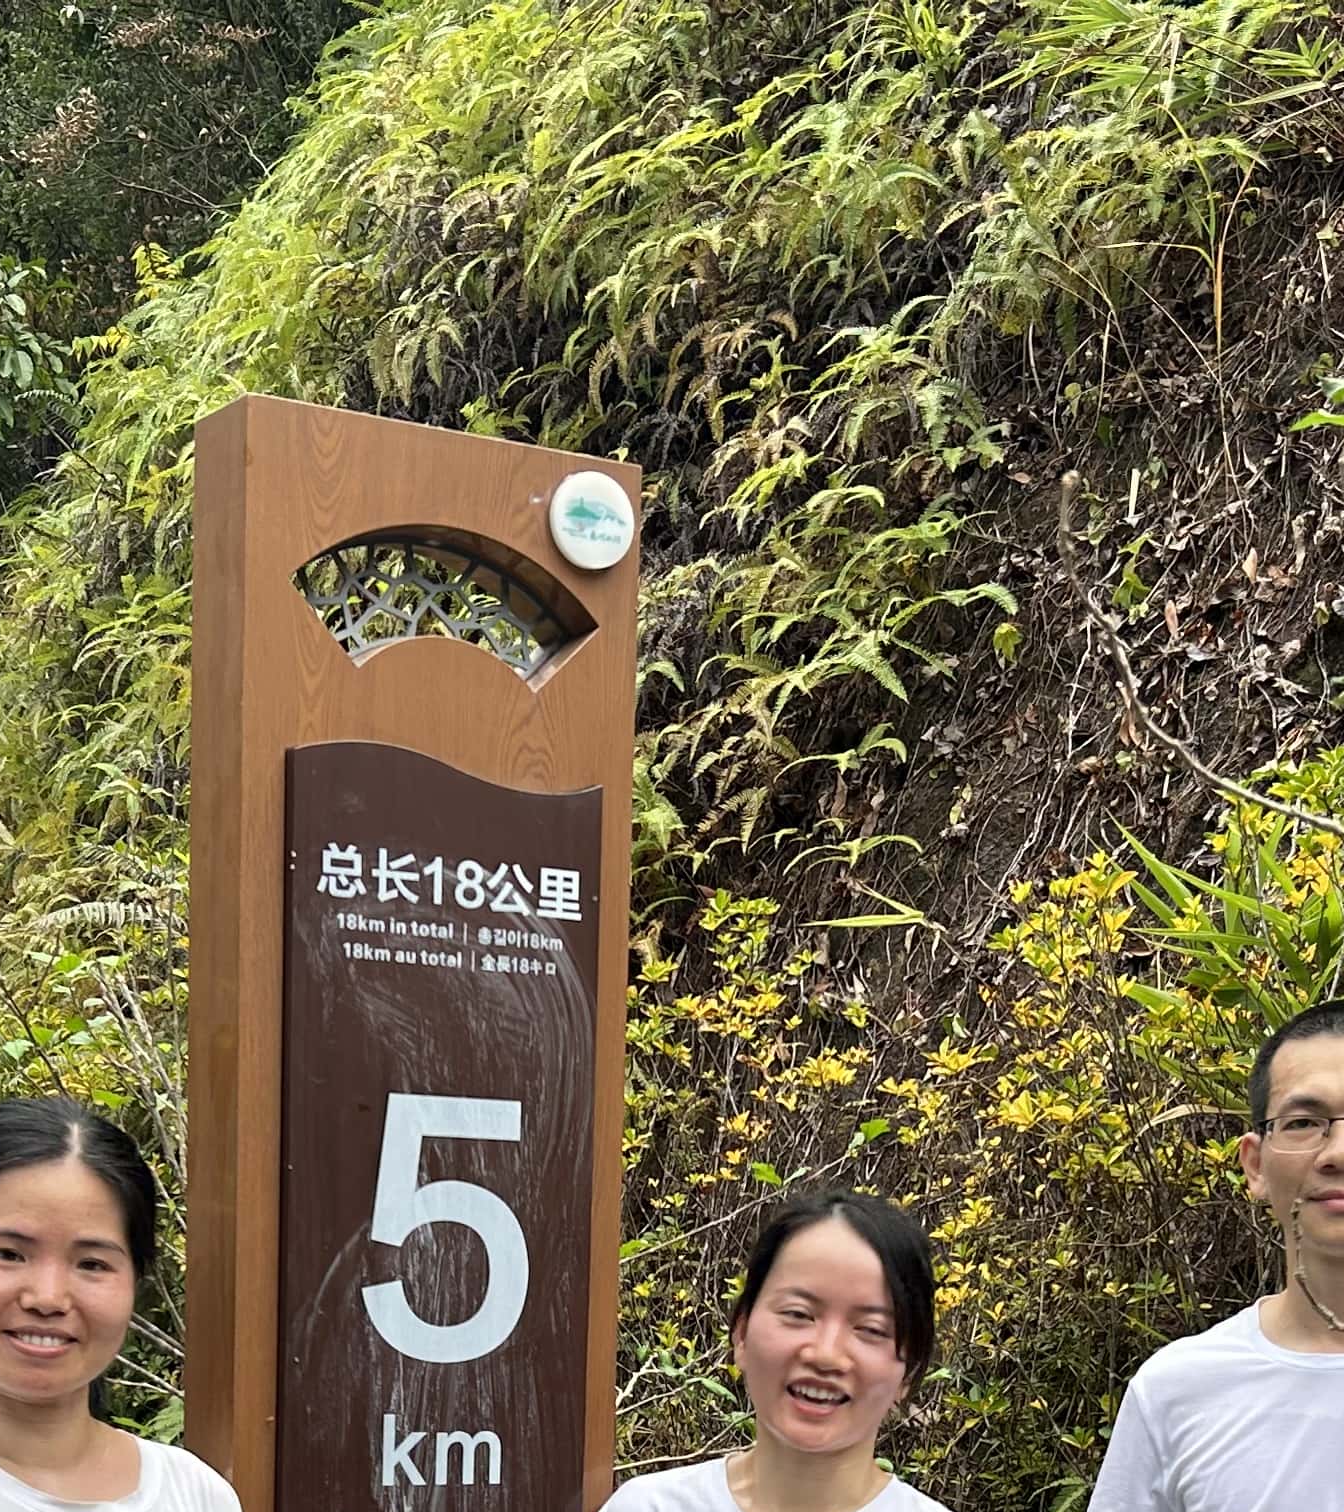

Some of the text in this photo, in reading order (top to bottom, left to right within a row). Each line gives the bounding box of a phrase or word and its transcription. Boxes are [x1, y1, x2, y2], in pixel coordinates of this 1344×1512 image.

[317, 842, 582, 921] 总长18公里
[336, 912, 454, 939] 18km in total
[342, 942, 462, 968] 18km au total
[361, 1092, 530, 1364] 5
[382, 1414, 502, 1487] km
